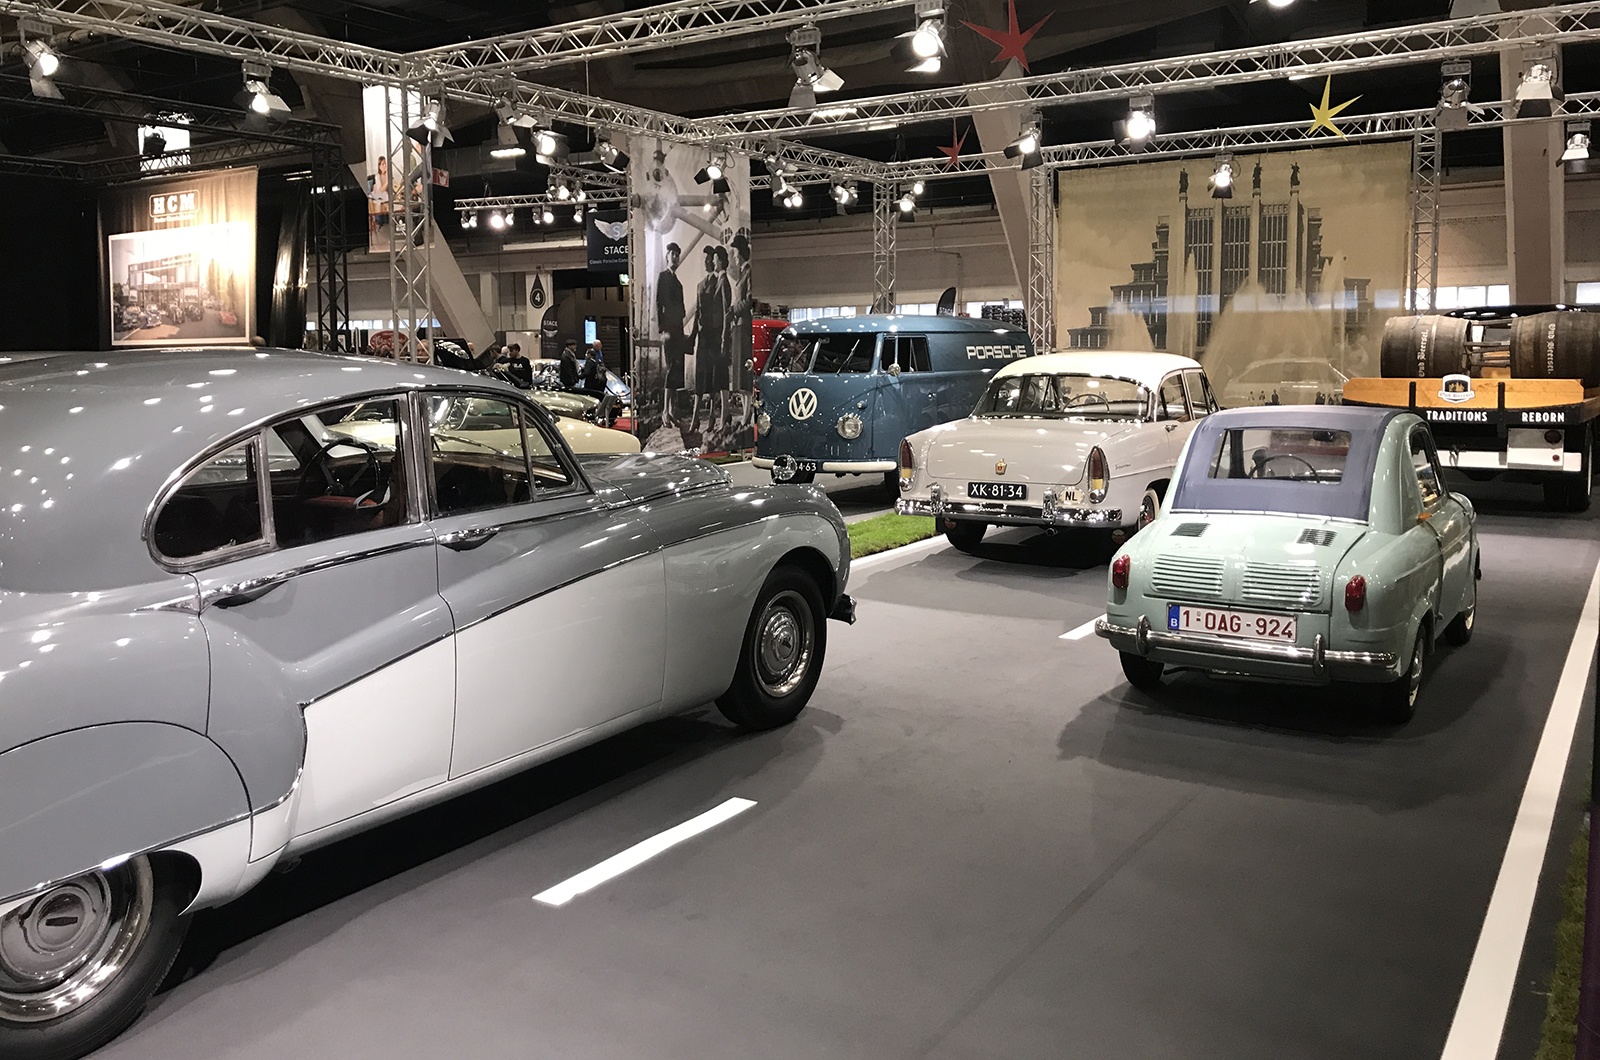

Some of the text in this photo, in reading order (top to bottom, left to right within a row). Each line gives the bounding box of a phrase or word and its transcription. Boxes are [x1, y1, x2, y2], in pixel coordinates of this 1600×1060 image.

[153, 193, 195, 214] HCM
[604, 245, 629, 255] STACE
[534, 292, 541, 302] 4
[966, 345, 1027, 359] PORSCHE
[1426, 410, 1488, 422] TRADITIONS
[1521, 411, 1565, 423] REBORN
[798, 462, 817, 472] 4-63
[970, 483, 1023, 498] XK-81-34
[1065, 491, 1078, 501] NL
[1170, 617, 1178, 627] B
